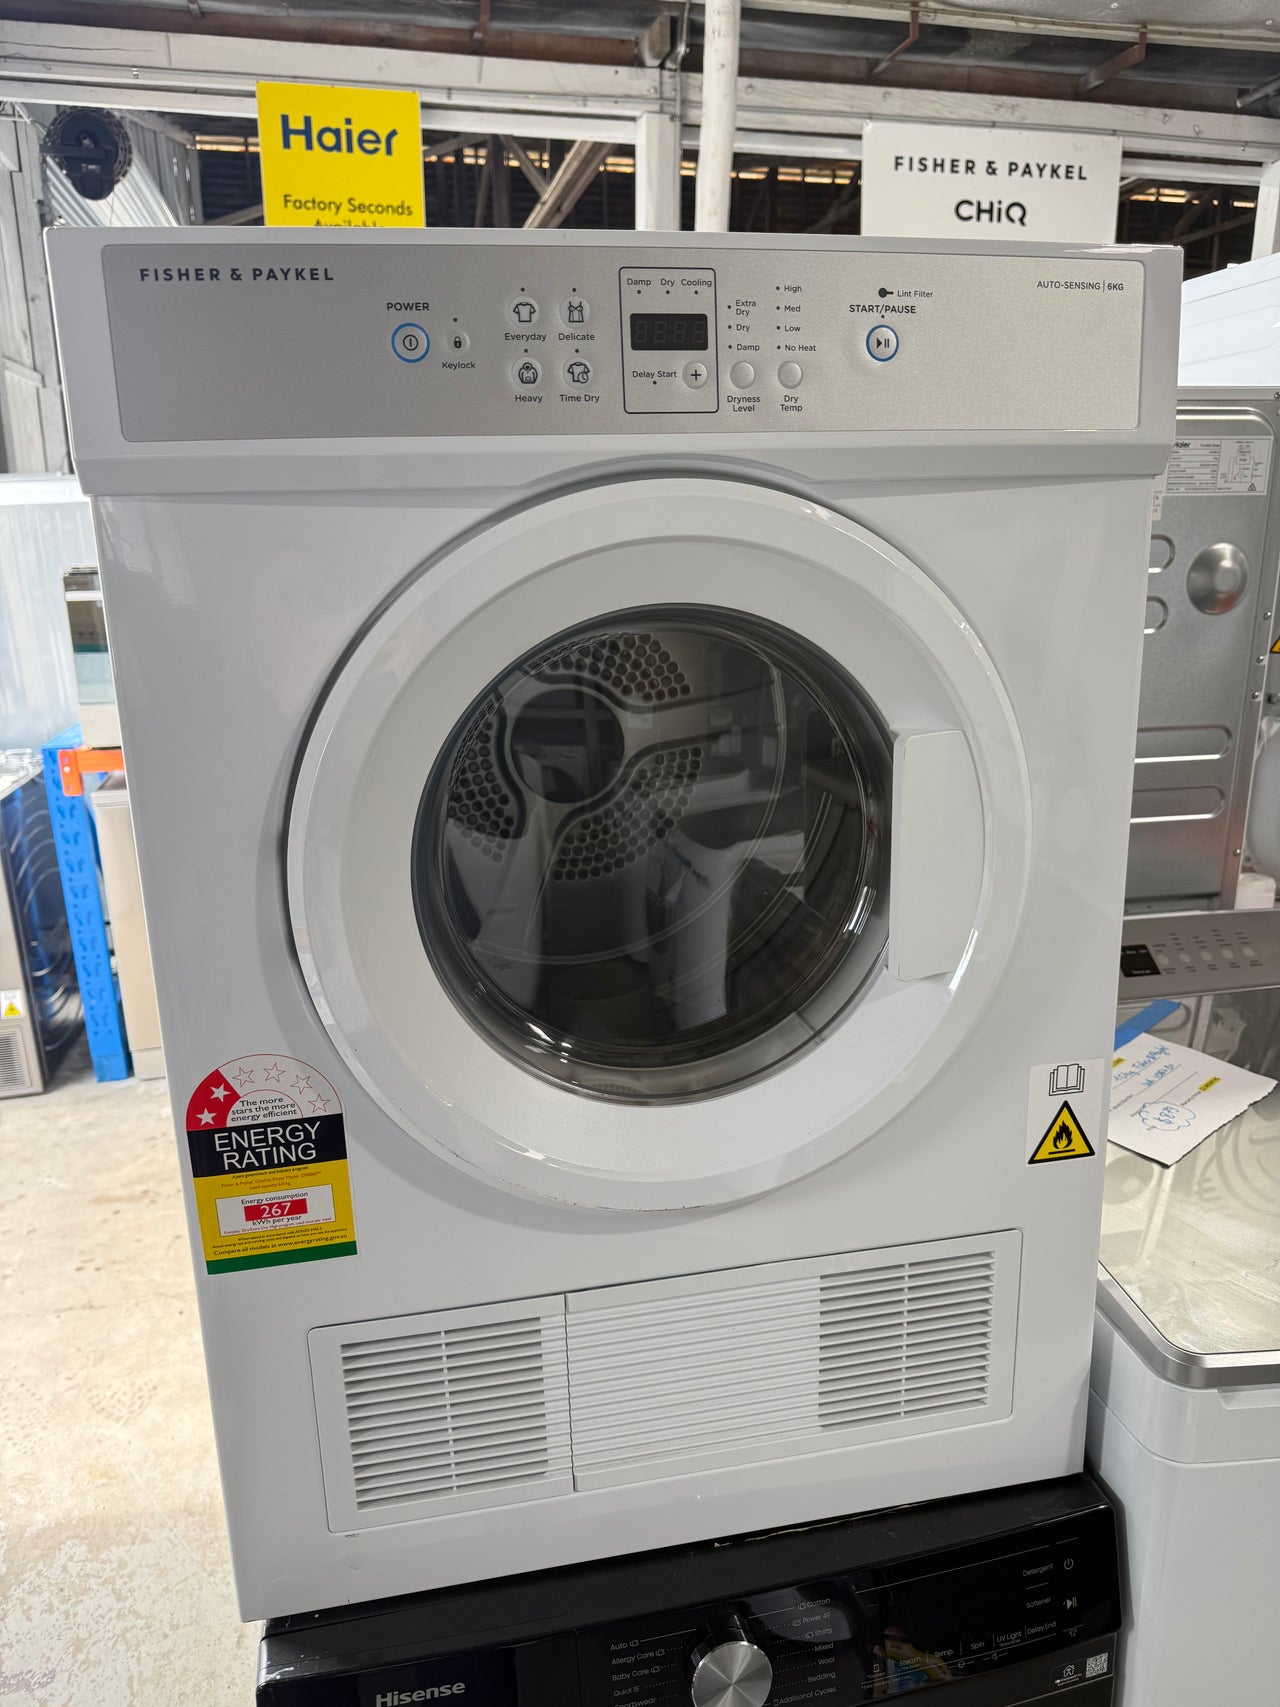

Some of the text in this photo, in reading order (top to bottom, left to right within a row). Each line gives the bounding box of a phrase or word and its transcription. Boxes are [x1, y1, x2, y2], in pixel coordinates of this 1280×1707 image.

[281, 114, 398, 156] Haier
[894, 156, 1087, 181] FISHER & PAYKEL
[283, 194, 413, 217] Factory Seconds
[954, 199, 1027, 227] CHiQ
[140, 268, 334, 281] FISHER & PAYKEL
[627, 278, 651, 287] Damp
[660, 278, 675, 287] Dry
[681, 278, 712, 288] Cooling
[1036, 281, 1124, 291] AUTO-SENSING 6KG
[784, 285, 802, 293] High
[913, 290, 933, 298] Filter
[386, 302, 430, 311] POWER
[849, 304, 916, 314] START/PAUSE
[735, 308, 750, 317] Dry
[736, 324, 750, 332] Dry
[504, 333, 547, 343] Everyday
[558, 332, 595, 341] Delicate
[736, 344, 760, 352] Damp
[785, 344, 816, 352] No Heat
[442, 361, 476, 370] Keylock
[632, 370, 677, 379] Delay Start
[515, 394, 543, 404] Heavy
[560, 394, 600, 404] Time Dry
[727, 395, 761, 404] Dryness
[784, 395, 799, 404] Dry
[732, 404, 755, 412] Level
[780, 404, 803, 413] Temp
[240, 1099, 257, 1107] The
[232, 1107, 253, 1115] stars
[255, 1105, 269, 1113] the
[231, 1109, 297, 1122] energy efficient
[214, 1121, 320, 1152] ENERGY
[223, 1142, 316, 1171] RATING
[241, 1190, 308, 1205] Energy consumption
[260, 1202, 291, 1219] 267
[272, 1217, 287, 1225] per
[213, 1247, 240, 1256] Compare
[249, 1243, 270, 1251] models
[1022, 1563, 1054, 1577] Detergent
[807, 1598, 831, 1608] Cotton
[1026, 1597, 1052, 1608] Softener
[802, 1613, 822, 1624] Power
[814, 1627, 833, 1637] Shirts
[1027, 1620, 1056, 1635] Delay End
[997, 1631, 1022, 1643] UV Light
[815, 1642, 834, 1652] Mixed
[970, 1641, 985, 1650] Spin
[612, 1655, 635, 1665] Allergy
[818, 1656, 835, 1665] Wool
[899, 1656, 921, 1667] Steam
[612, 1669, 650, 1682] Baby Care
[807, 1671, 836, 1683] Bedding
[376, 1682, 466, 1707] Hisense
[613, 1688, 632, 1697] Quick
[780, 1686, 837, 1704] Additional Cycles
